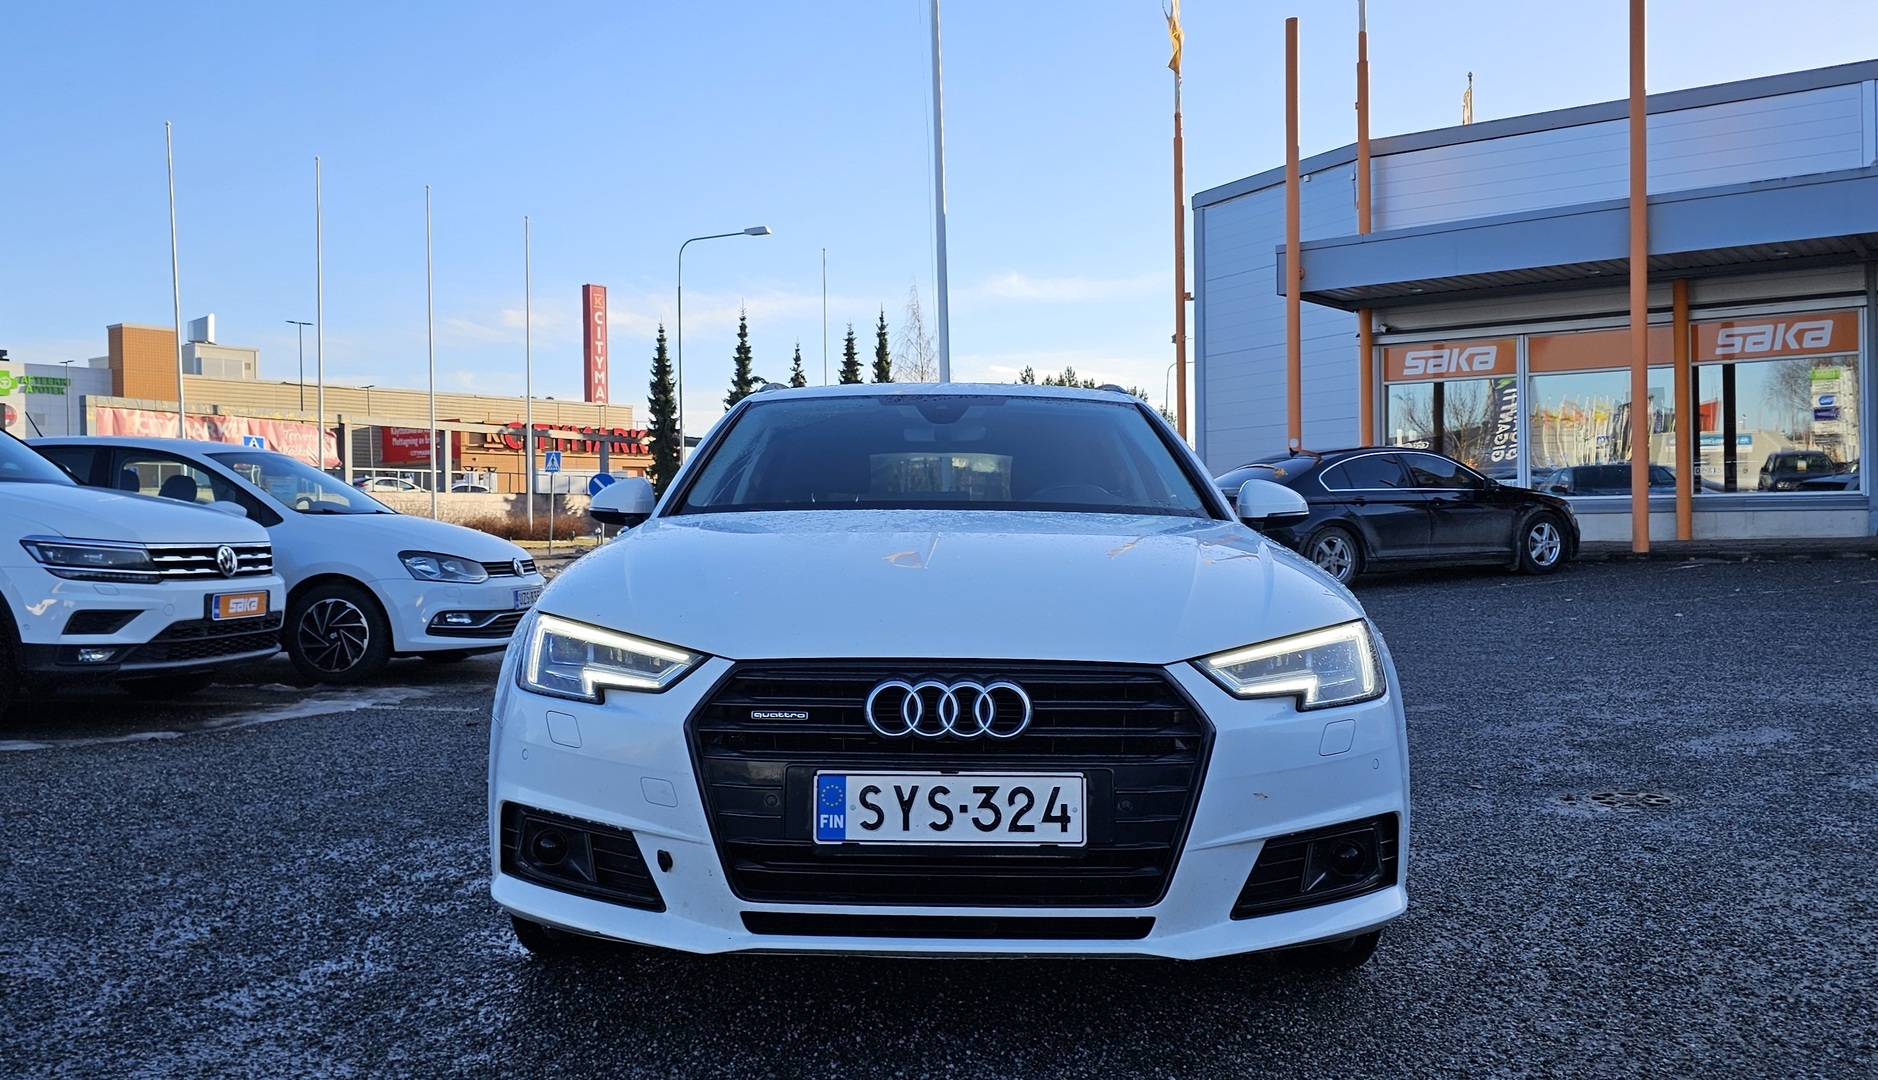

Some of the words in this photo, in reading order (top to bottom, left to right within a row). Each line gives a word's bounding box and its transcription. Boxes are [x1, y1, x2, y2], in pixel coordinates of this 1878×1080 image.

[594, 311, 605, 405] CITYMA
[505, 421, 649, 454] CTYMARK
[820, 814, 844, 829] FIN
[858, 785, 1071, 832] SYS-324
